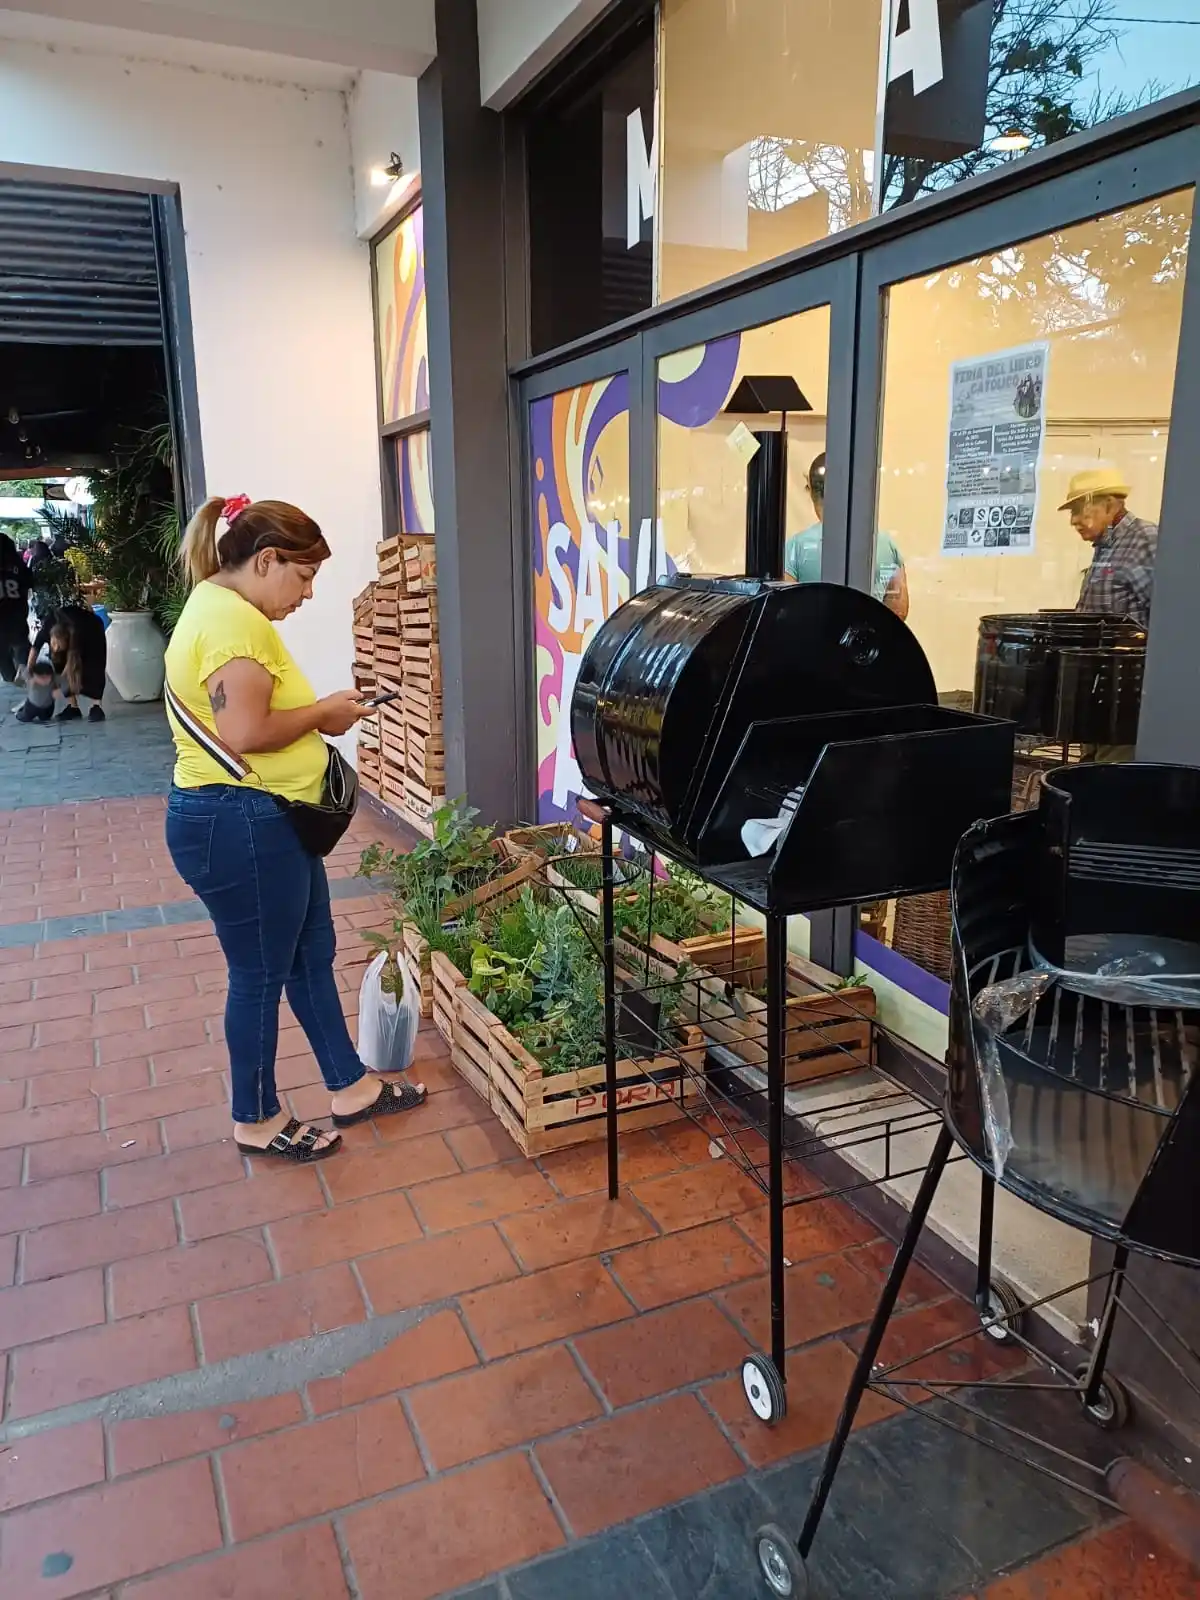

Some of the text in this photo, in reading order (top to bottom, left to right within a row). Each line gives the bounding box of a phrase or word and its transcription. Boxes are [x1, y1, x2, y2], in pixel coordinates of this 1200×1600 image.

[955, 355, 1042, 384] FERIA DEL LIBRO
